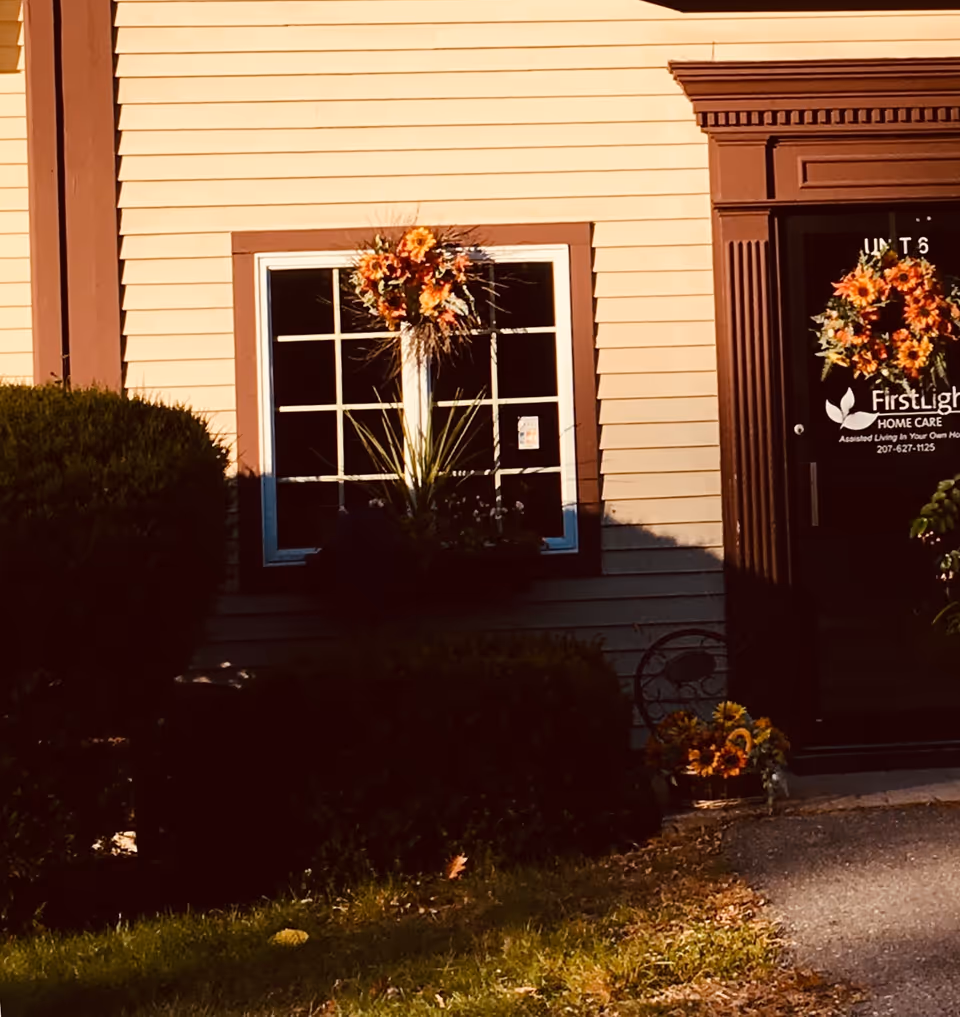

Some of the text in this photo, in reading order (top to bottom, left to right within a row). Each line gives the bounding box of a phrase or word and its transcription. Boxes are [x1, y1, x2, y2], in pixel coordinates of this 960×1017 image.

[864, 237, 929, 255] UNT 6
[877, 417, 942, 429] HOME CARE
[839, 434, 873, 443] Assisted
[874, 433, 898, 443] Living
[909, 432, 927, 441] Your
[929, 431, 947, 440] Own
[876, 443, 936, 454] 207-627-1125
